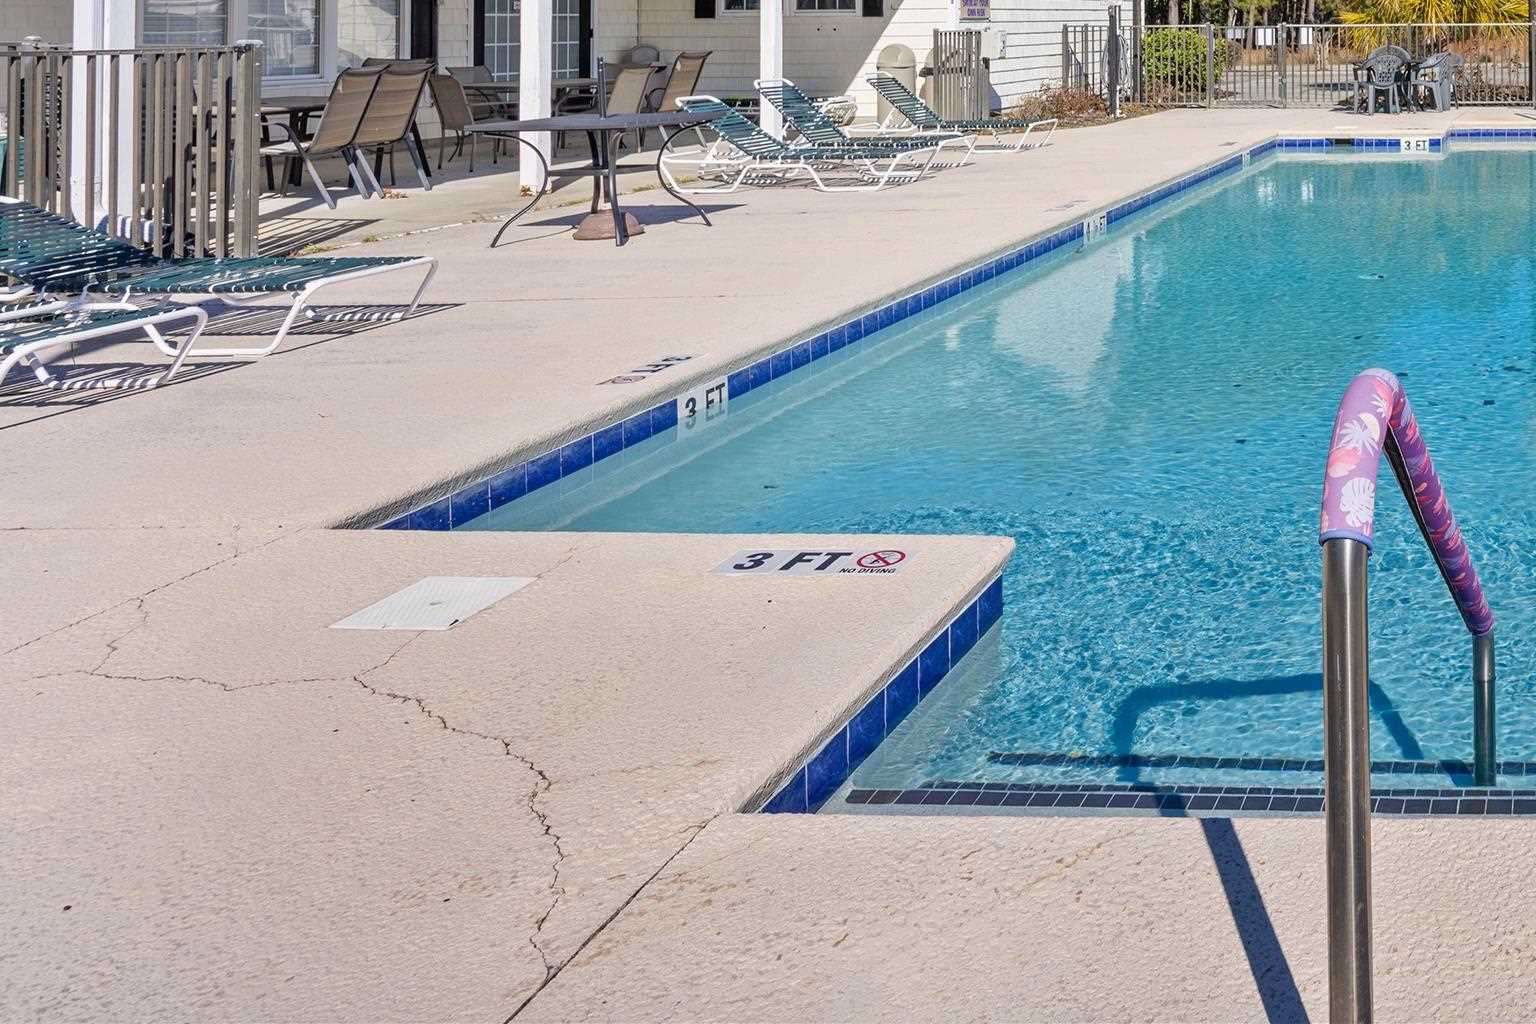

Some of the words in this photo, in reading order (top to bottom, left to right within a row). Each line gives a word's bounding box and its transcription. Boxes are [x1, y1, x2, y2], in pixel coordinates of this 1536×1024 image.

[685, 397, 697, 418] 3
[705, 383, 726, 409] FT
[732, 552, 774, 570] 3
[778, 552, 854, 571] FT
